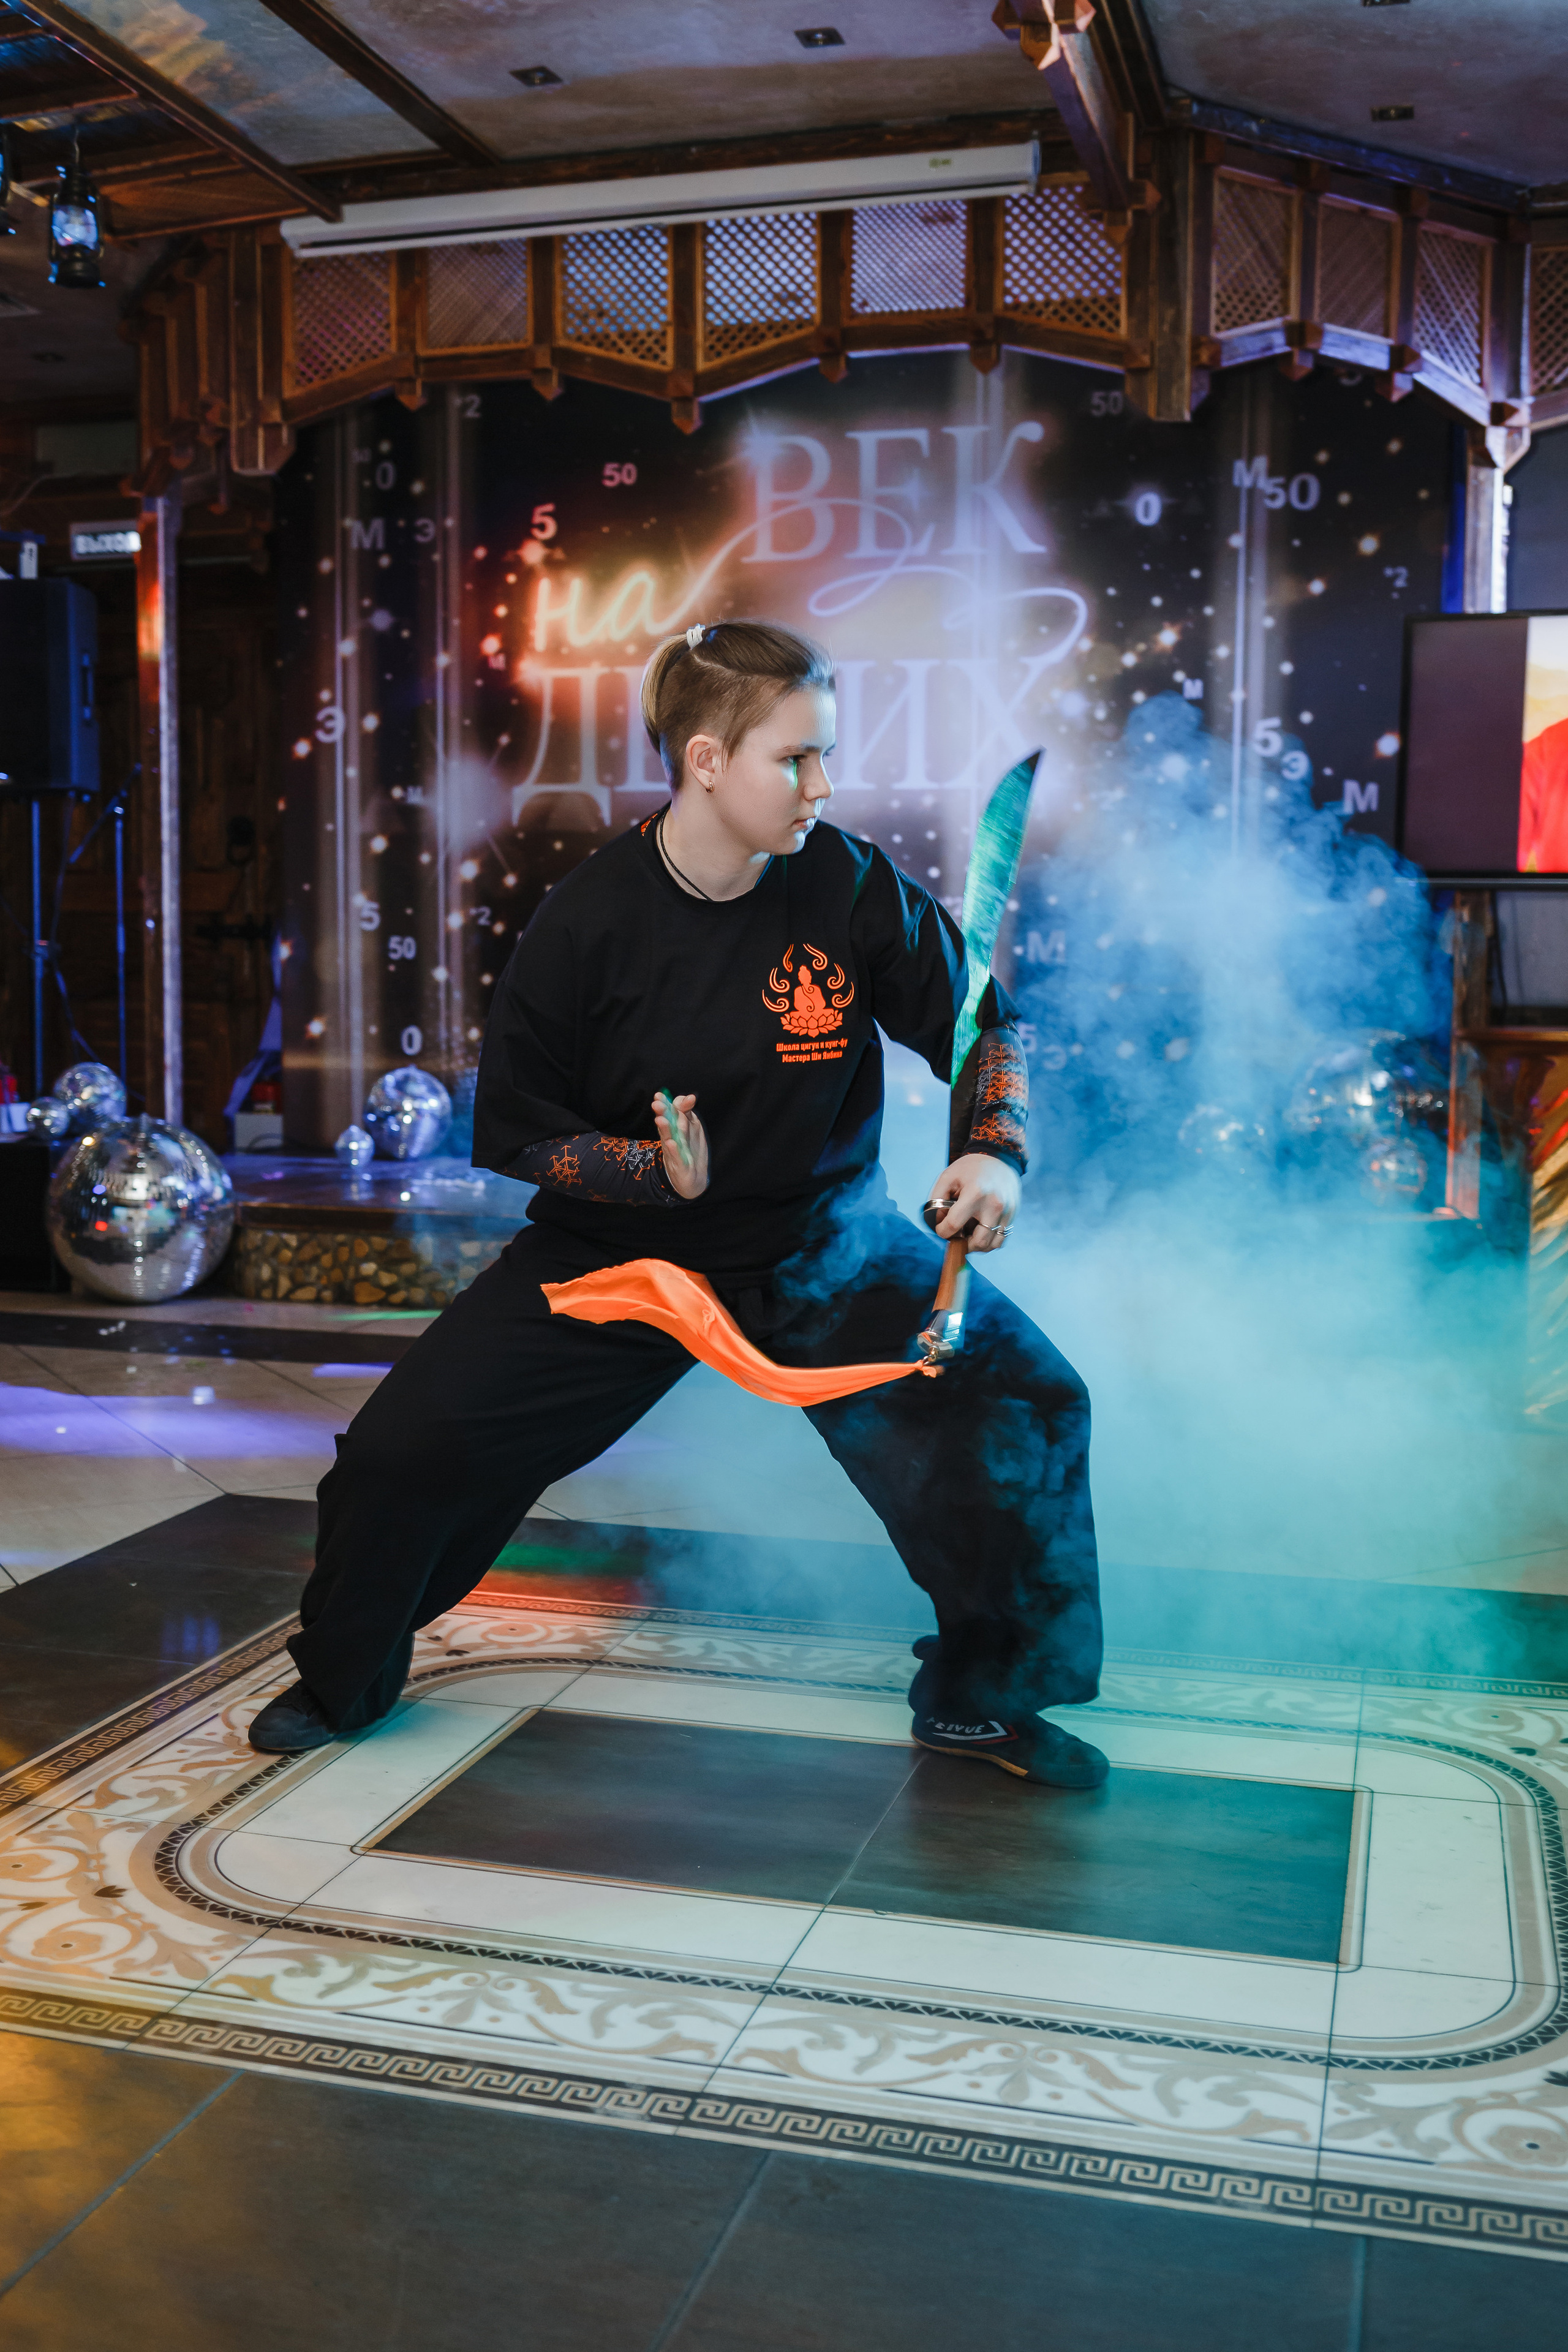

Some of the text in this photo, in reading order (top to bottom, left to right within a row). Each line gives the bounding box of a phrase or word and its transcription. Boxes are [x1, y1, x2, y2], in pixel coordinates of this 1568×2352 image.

[601, 462, 638, 488] 50
[742, 421, 1047, 563] ВЕК
[530, 503, 558, 540] 5
[512, 658, 1058, 826] ДИХ
[388, 935, 417, 960] 50
[776, 1042, 800, 1052] Школа
[801, 1042, 820, 1051] цигун
[825, 1038, 848, 1049] кунг-фу
[782, 1054, 810, 1063] Мастера
[811, 1052, 822, 1061] Ши
